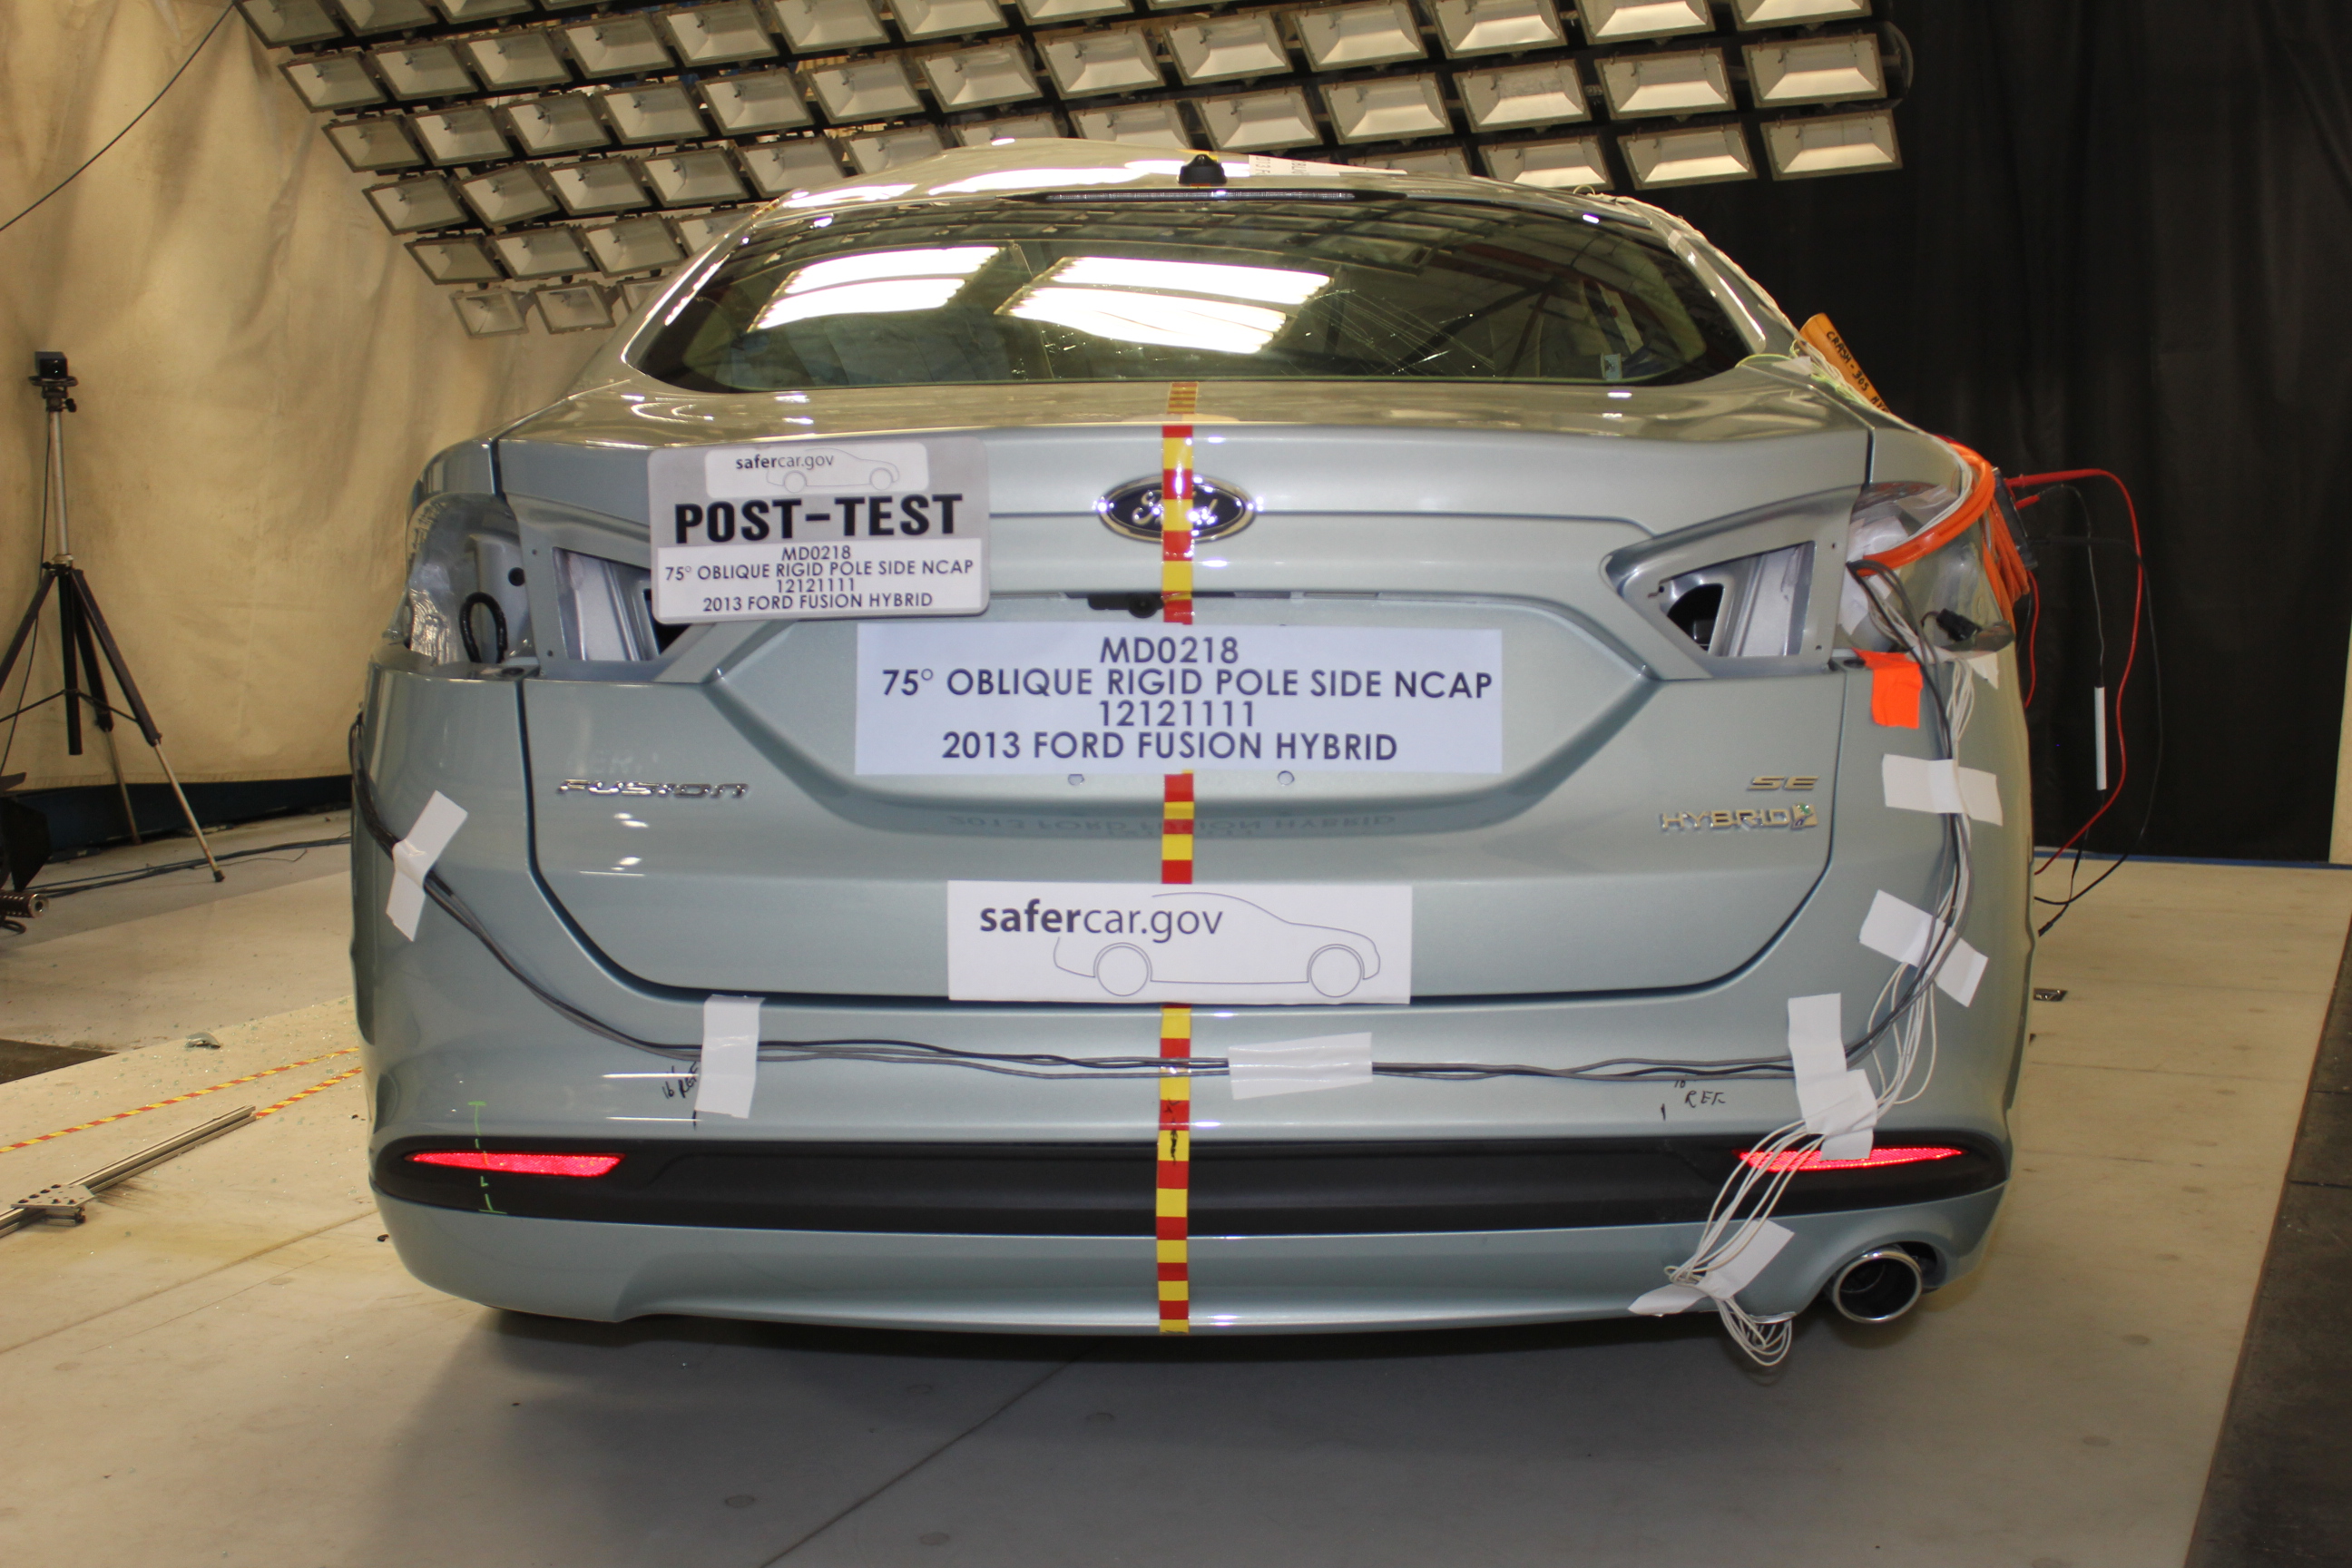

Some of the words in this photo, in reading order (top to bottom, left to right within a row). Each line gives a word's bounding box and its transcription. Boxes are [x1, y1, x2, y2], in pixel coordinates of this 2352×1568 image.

[1826, 330, 1852, 364] CRASH
[735, 453, 835, 471] safercar.gov
[674, 493, 964, 544] POST-TEST
[780, 544, 852, 562] MD0218
[664, 564, 692, 582] 75°
[697, 563, 770, 581] OBLIQUE
[776, 562, 824, 578] RIGID
[829, 560, 873, 576] POLE
[877, 560, 916, 575] SIDE
[921, 559, 974, 575] NCAP
[775, 577, 855, 594] 12121111
[702, 596, 742, 612] 2013
[747, 594, 794, 611] FORD
[799, 593, 863, 610] FUSION
[868, 592, 934, 608] HYBRID
[1099, 636, 1240, 664] MD0218
[881, 668, 935, 697] 75°
[946, 667, 1093, 697] OBLIQUE
[1106, 668, 1204, 696] RIGID
[1215, 668, 1298, 697] POLE
[1309, 668, 1383, 698] SIDE
[1394, 670, 1494, 701] NCAP
[1098, 700, 1255, 727] 12121111
[941, 730, 1022, 760] 2013
[1033, 730, 1125, 760] FORD
[1136, 730, 1263, 760] FUSION
[1274, 731, 1398, 761] HYBRID
[555, 778, 750, 799] FUSION
[1746, 775, 1819, 791] SE
[1660, 808, 1792, 831] HYBRID
[979, 897, 1223, 944] safercar.gov
